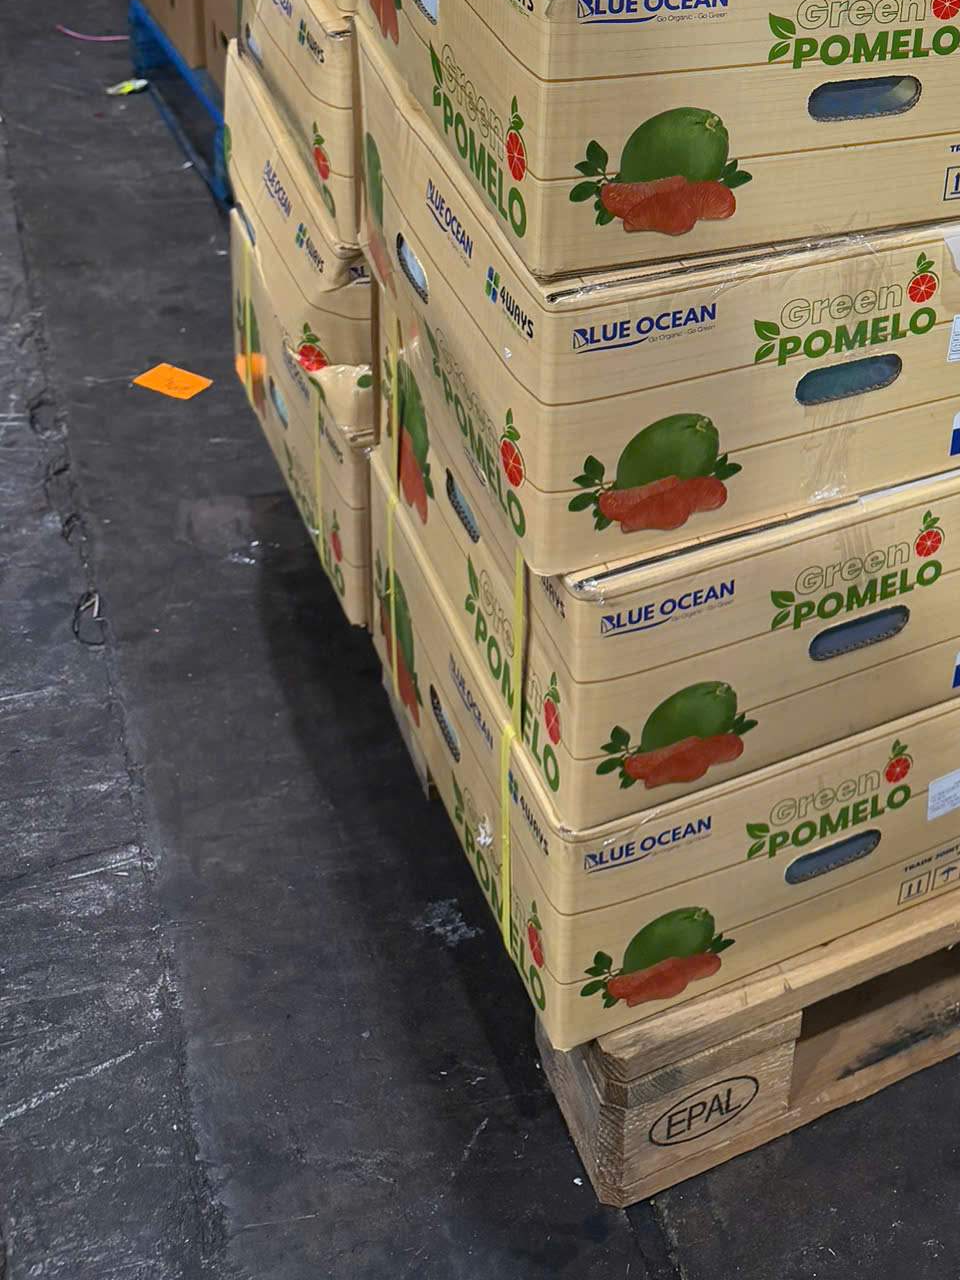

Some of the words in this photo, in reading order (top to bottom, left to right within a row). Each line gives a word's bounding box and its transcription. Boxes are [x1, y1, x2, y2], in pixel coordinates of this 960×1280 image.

[793, 24, 960, 69] POMELO
[443, 93, 527, 239] POMELO
[444, 207, 473, 260] OCEAN
[500, 286, 534, 340] 4WAYS
[572, 320, 632, 350] BLUE
[636, 303, 717, 335] OCEAN
[780, 281, 903, 329] Green
[777, 306, 937, 366] POMELO
[792, 559, 944, 631] POMELO
[795, 540, 911, 596] Green
[601, 603, 656, 634] BLUE
[659, 580, 736, 619] OCEAN
[767, 784, 912, 858] POMELO
[769, 768, 882, 828] Green
[584, 843, 638, 871] BLUE
[640, 815, 712, 852] OCEAN
[665, 1087, 742, 1141] EPAL
